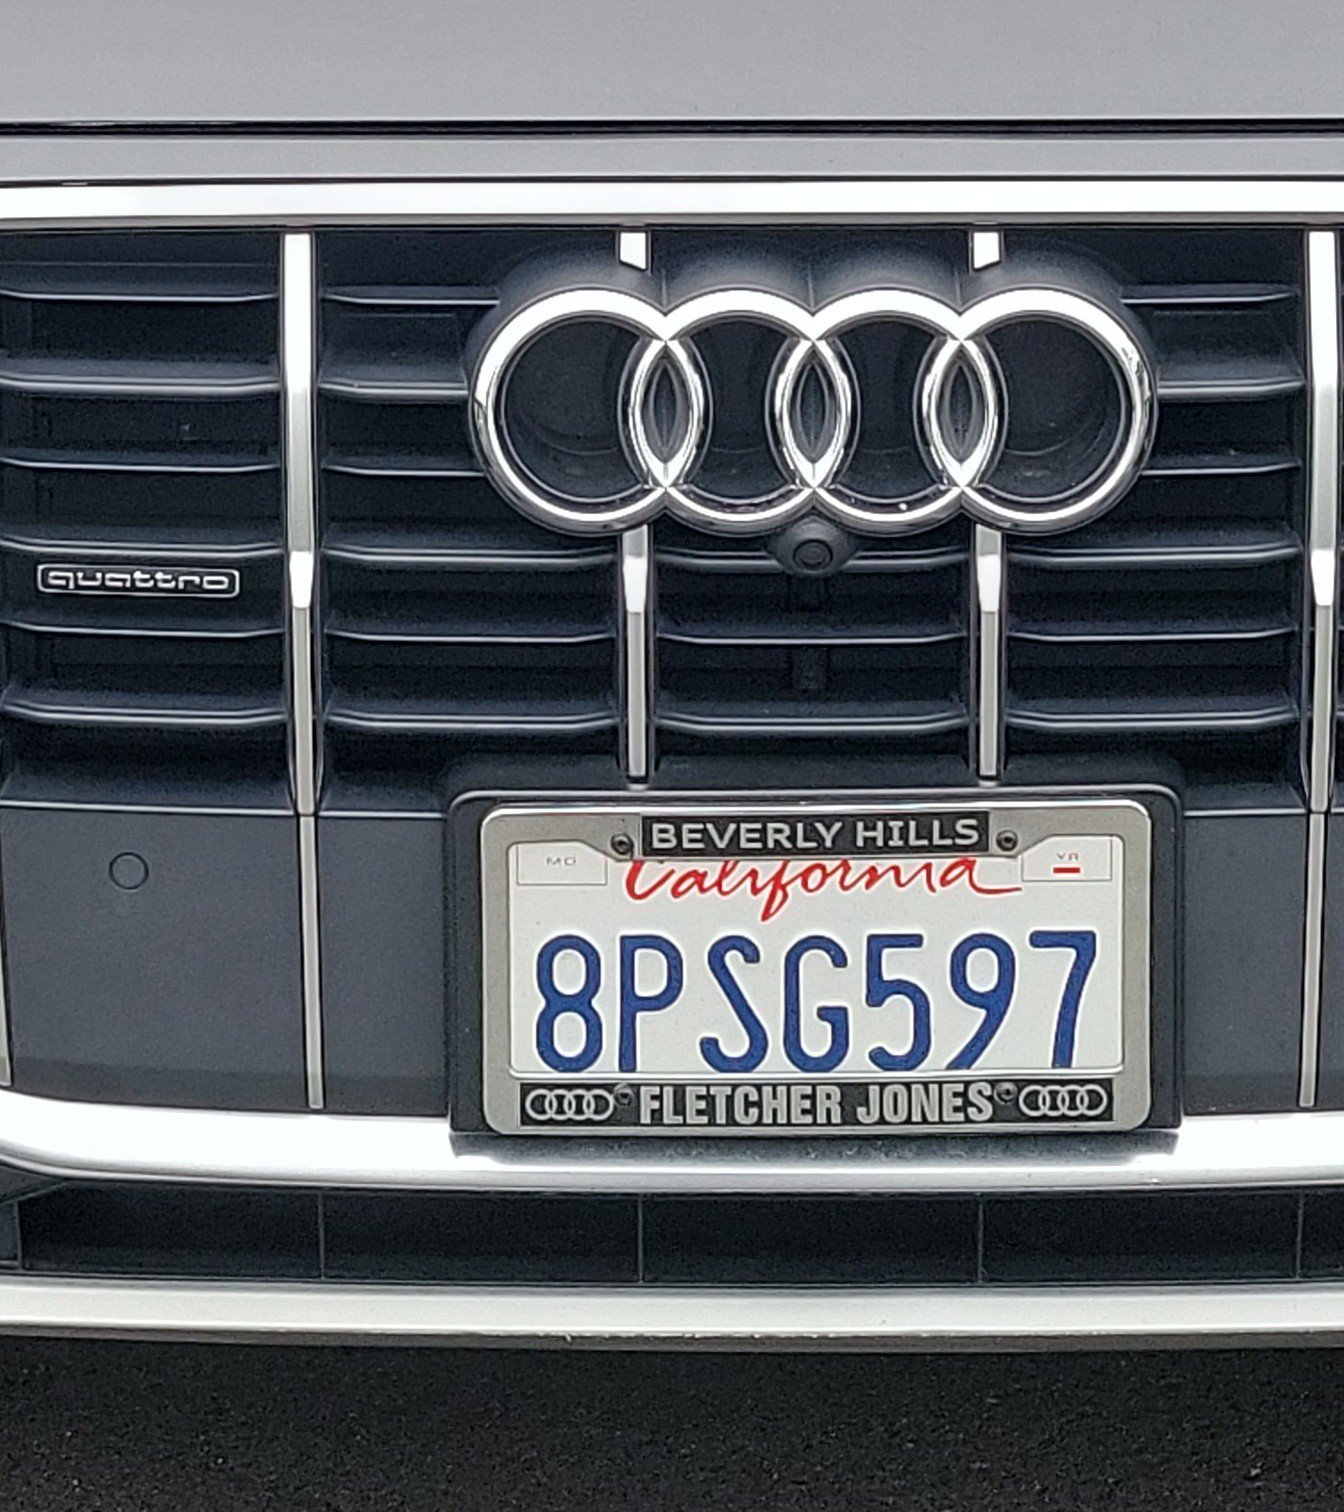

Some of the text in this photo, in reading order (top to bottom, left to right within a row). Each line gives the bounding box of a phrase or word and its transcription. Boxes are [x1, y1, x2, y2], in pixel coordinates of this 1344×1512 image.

[47, 570, 229, 590] quattro
[651, 818, 980, 849] BEVERLY HILLS
[625, 859, 1023, 922] California
[535, 929, 1098, 1074] 8PSG597
[639, 1081, 994, 1125] FLETCHER JONES
